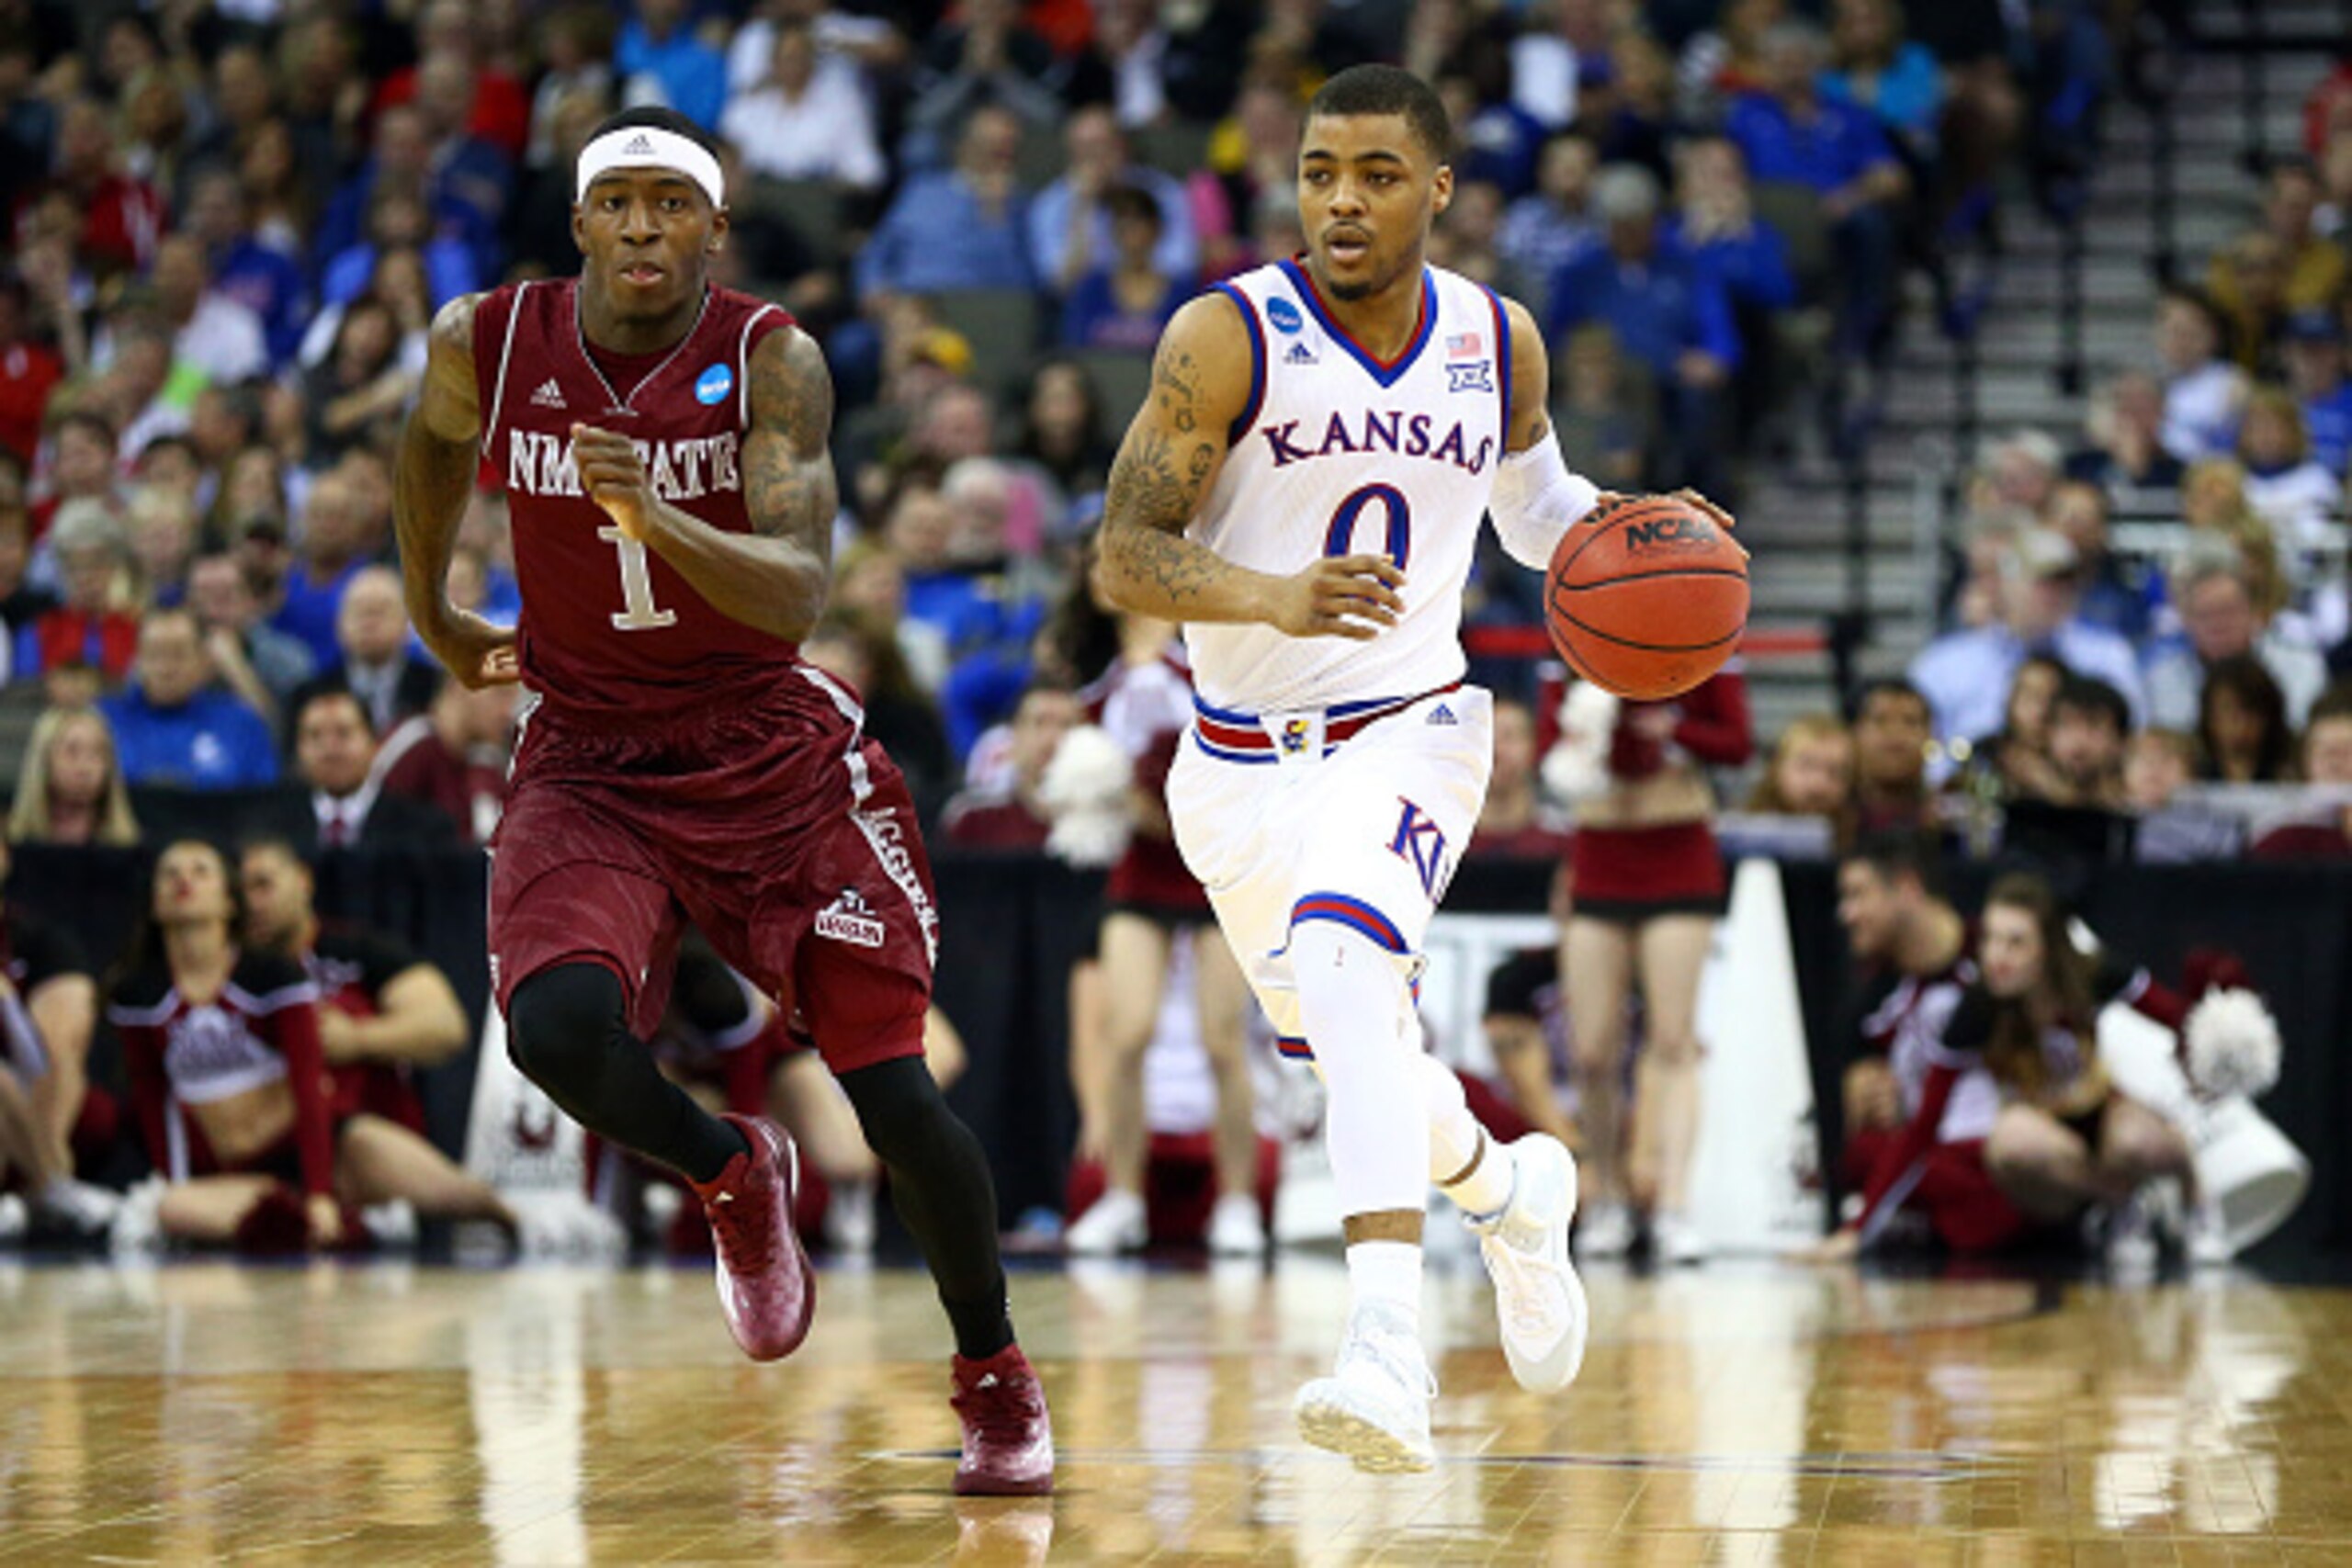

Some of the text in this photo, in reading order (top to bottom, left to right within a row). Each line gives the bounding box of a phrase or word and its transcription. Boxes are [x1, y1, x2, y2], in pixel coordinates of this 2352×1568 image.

[1262, 408, 1493, 475] KANSAS
[1626, 518, 1719, 550] NCAA
[597, 525, 678, 630] 1
